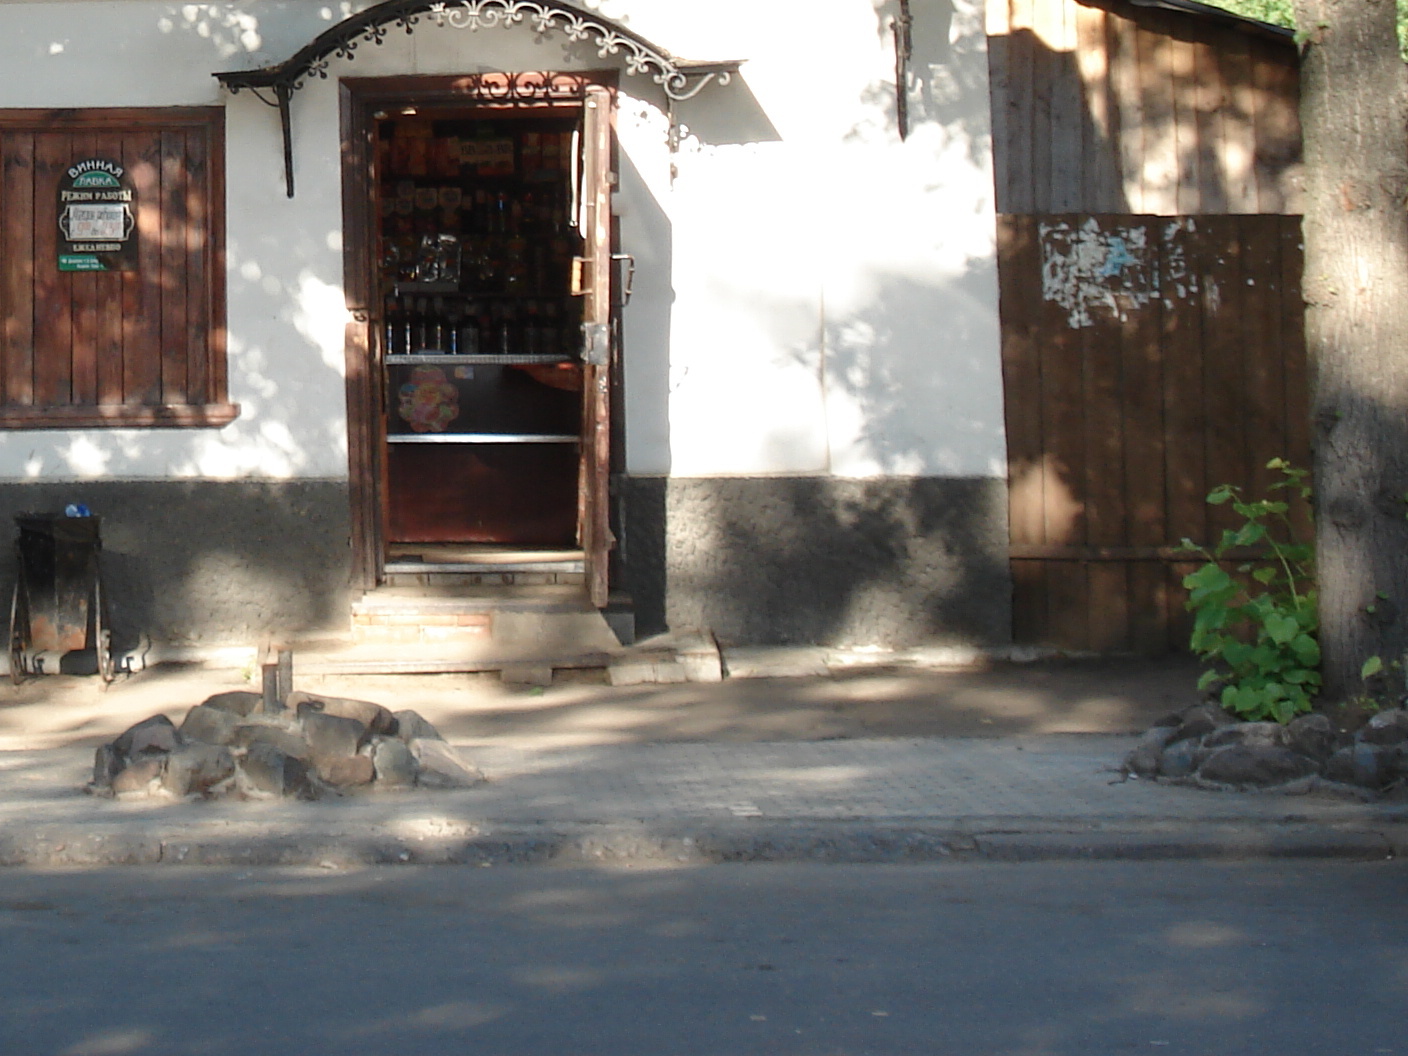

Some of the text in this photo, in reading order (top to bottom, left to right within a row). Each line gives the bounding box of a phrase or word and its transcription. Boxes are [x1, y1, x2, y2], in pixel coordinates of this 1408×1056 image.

[68, 160, 123, 178] ВИННАЯ
[79, 177, 112, 186] ЛАВКА
[61, 190, 132, 201] РЕЖИМ РАБОТЫ
